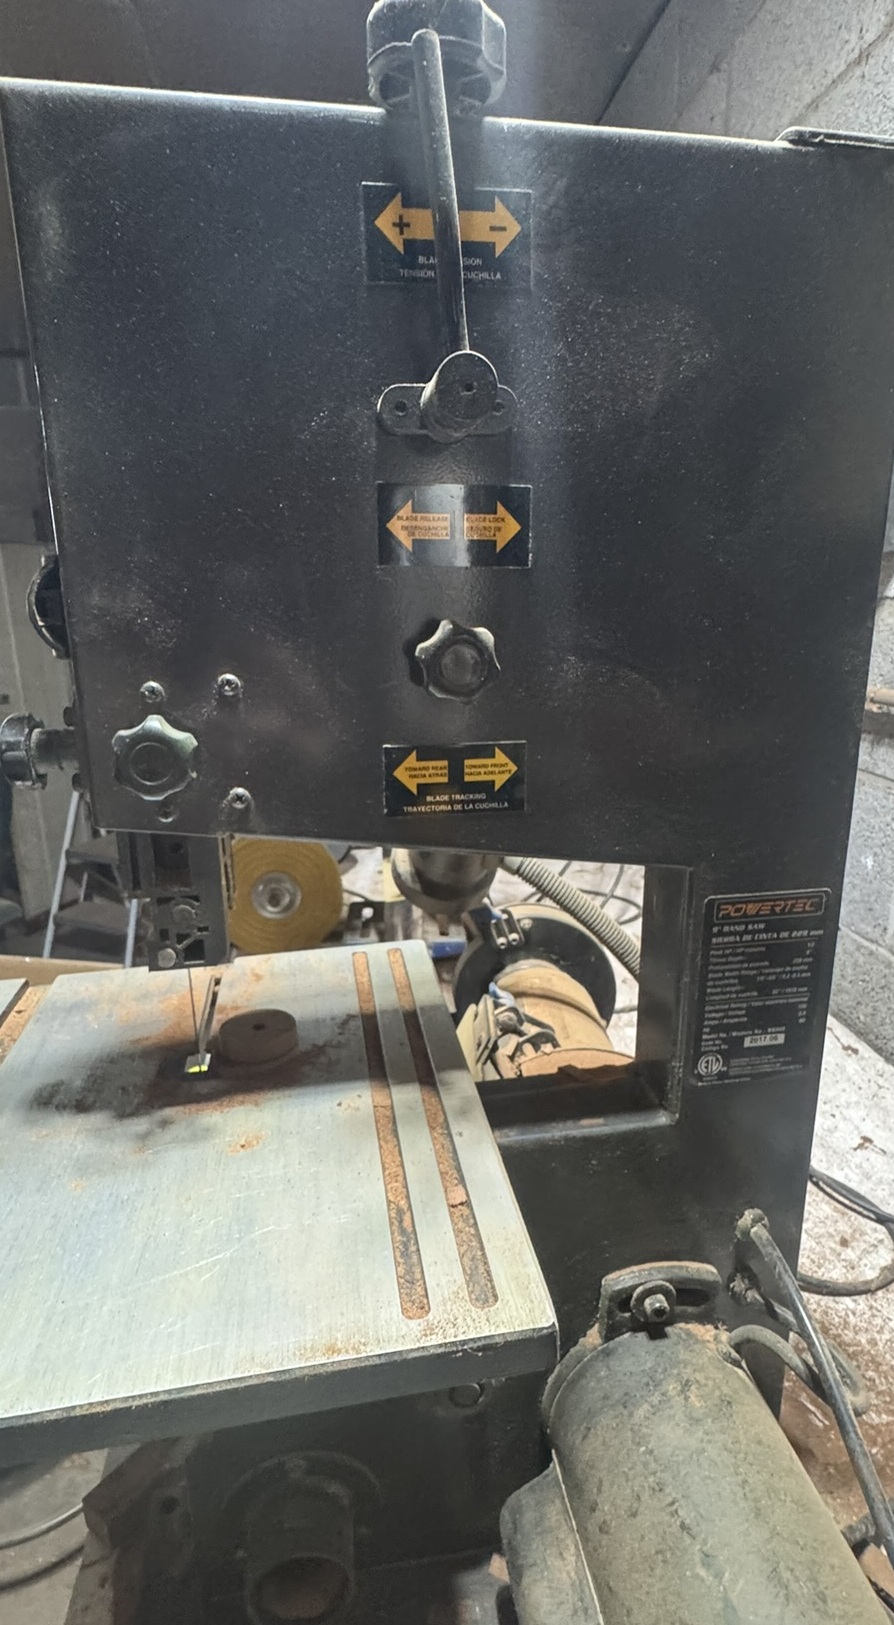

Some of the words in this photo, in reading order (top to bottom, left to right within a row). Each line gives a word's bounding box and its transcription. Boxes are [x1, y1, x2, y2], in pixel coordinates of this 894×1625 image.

[418, 255, 438, 264] BLA
[451, 793, 487, 802] TRACKING
[403, 804, 452, 813] TRAYECTORIA
[474, 801, 509, 809] CUCHILLA
[719, 899, 820, 918] POWERTEC
[746, 923, 767, 931] SAW
